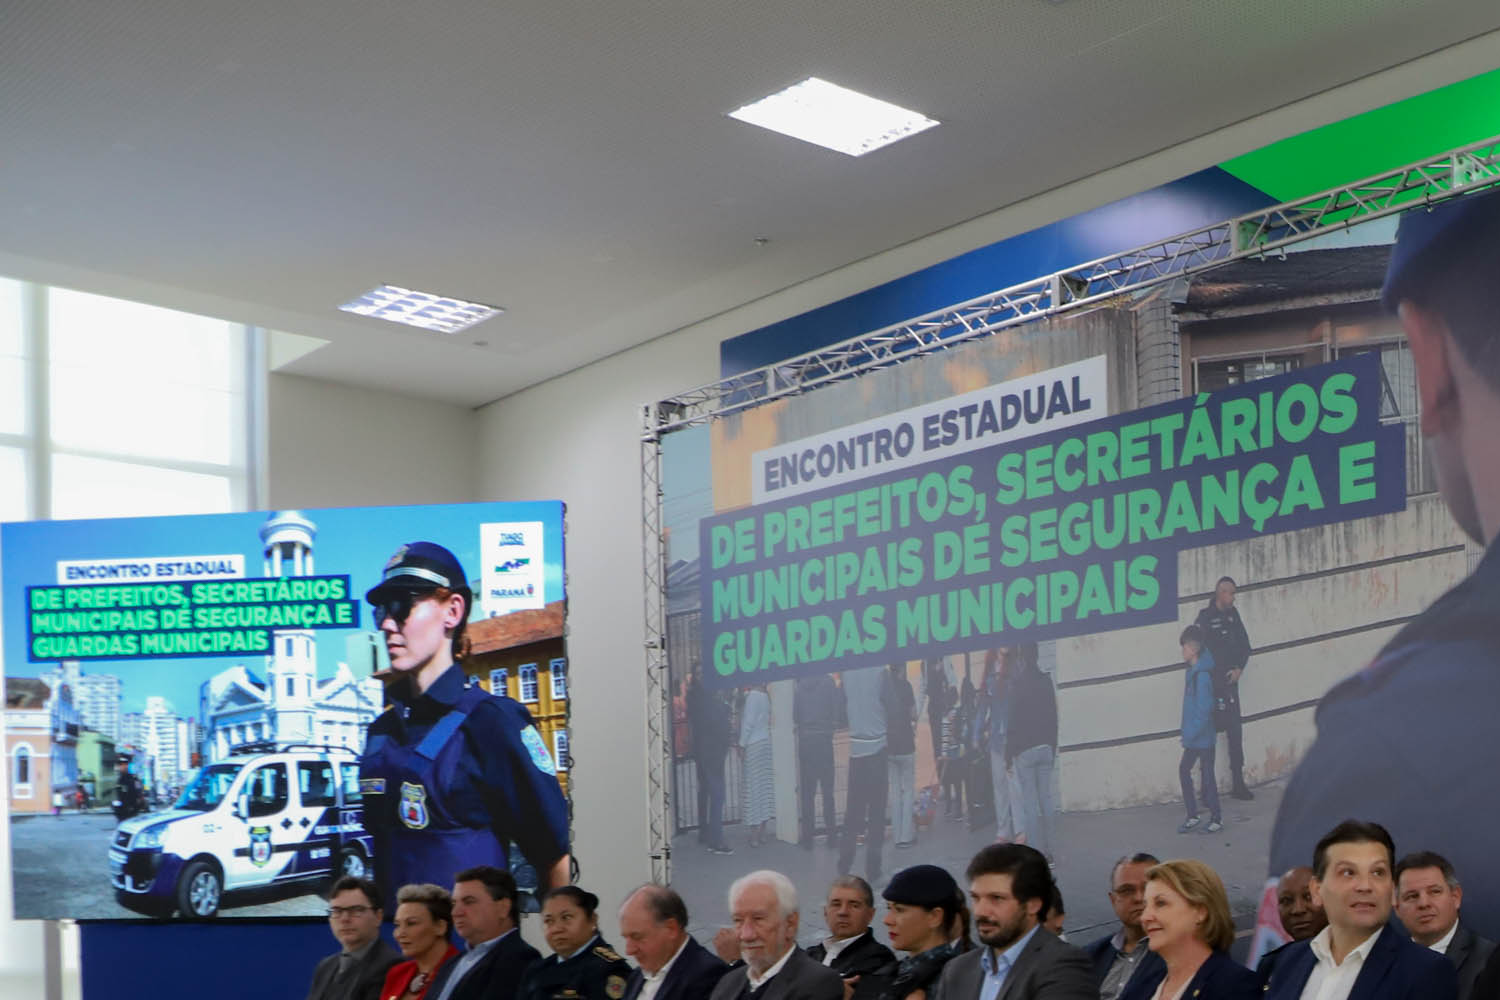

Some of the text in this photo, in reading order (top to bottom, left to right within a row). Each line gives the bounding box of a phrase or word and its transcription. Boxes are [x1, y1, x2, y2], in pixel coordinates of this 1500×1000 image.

[764, 376, 1091, 492] ENCONTRO ESTADUAL
[711, 373, 1358, 570] DE PREFEITOS, SECRETÁRIOS
[713, 442, 1377, 623] MUNICIPAIS DE SEGURANÇA E
[31, 577, 345, 610] DE PREFEITOS, SECRETÁRIOS
[66, 560, 237, 580] ENCONTRO ESTADUAL
[32, 603, 352, 634] MUNICIPAIS DE SEGURANÇA E
[33, 630, 269, 658] GUARDAS MUNICIPAIS
[713, 556, 1160, 676] GUARDAS MUNICIPAIS
